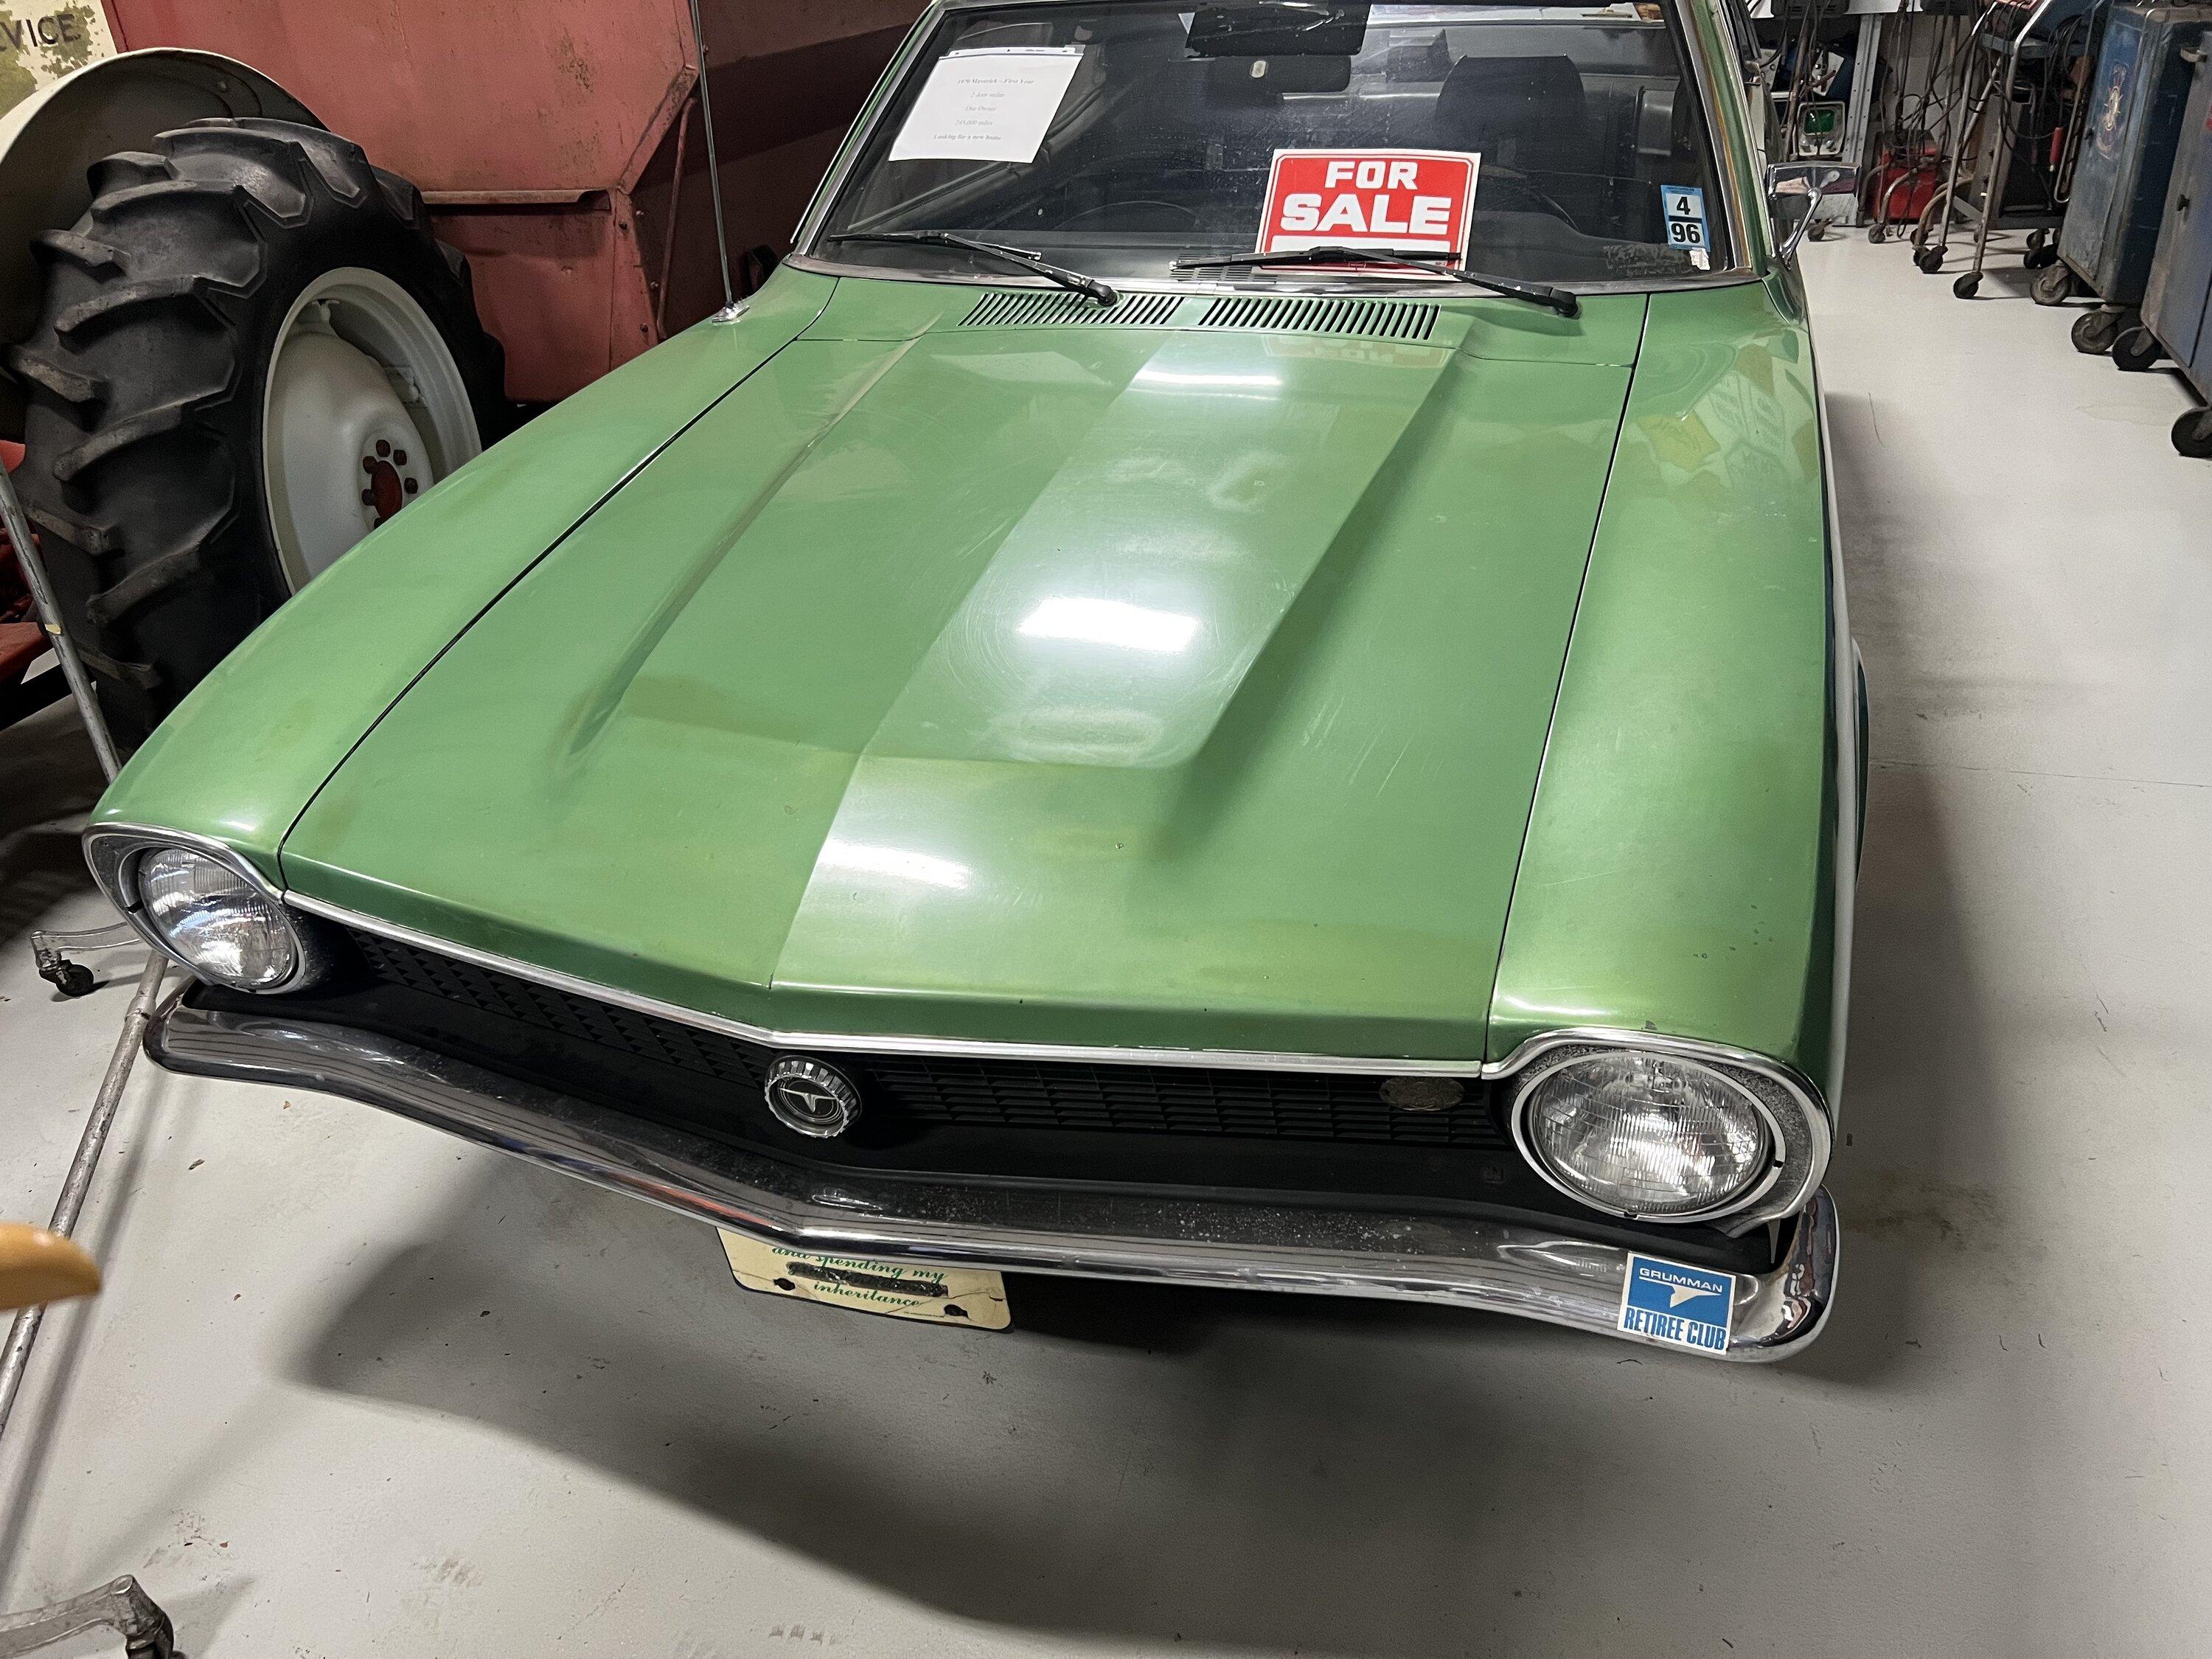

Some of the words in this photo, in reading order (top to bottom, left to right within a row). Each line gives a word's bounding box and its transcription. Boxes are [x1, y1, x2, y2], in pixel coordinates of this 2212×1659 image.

[0, 14, 82, 52] VICE
[1324, 161, 1419, 190] FOR
[1280, 193, 1453, 235] SALE
[1676, 196, 1691, 215] 4
[1671, 223, 1701, 244] 96
[815, 1256, 908, 1279] spending
[912, 1269, 949, 1286] my
[1638, 1267, 1724, 1293] GRUMMAN
[814, 1281, 920, 1307] inheritance
[1624, 1307, 1685, 1342] RETIREE
[1686, 1321, 1728, 1351] CLUB
